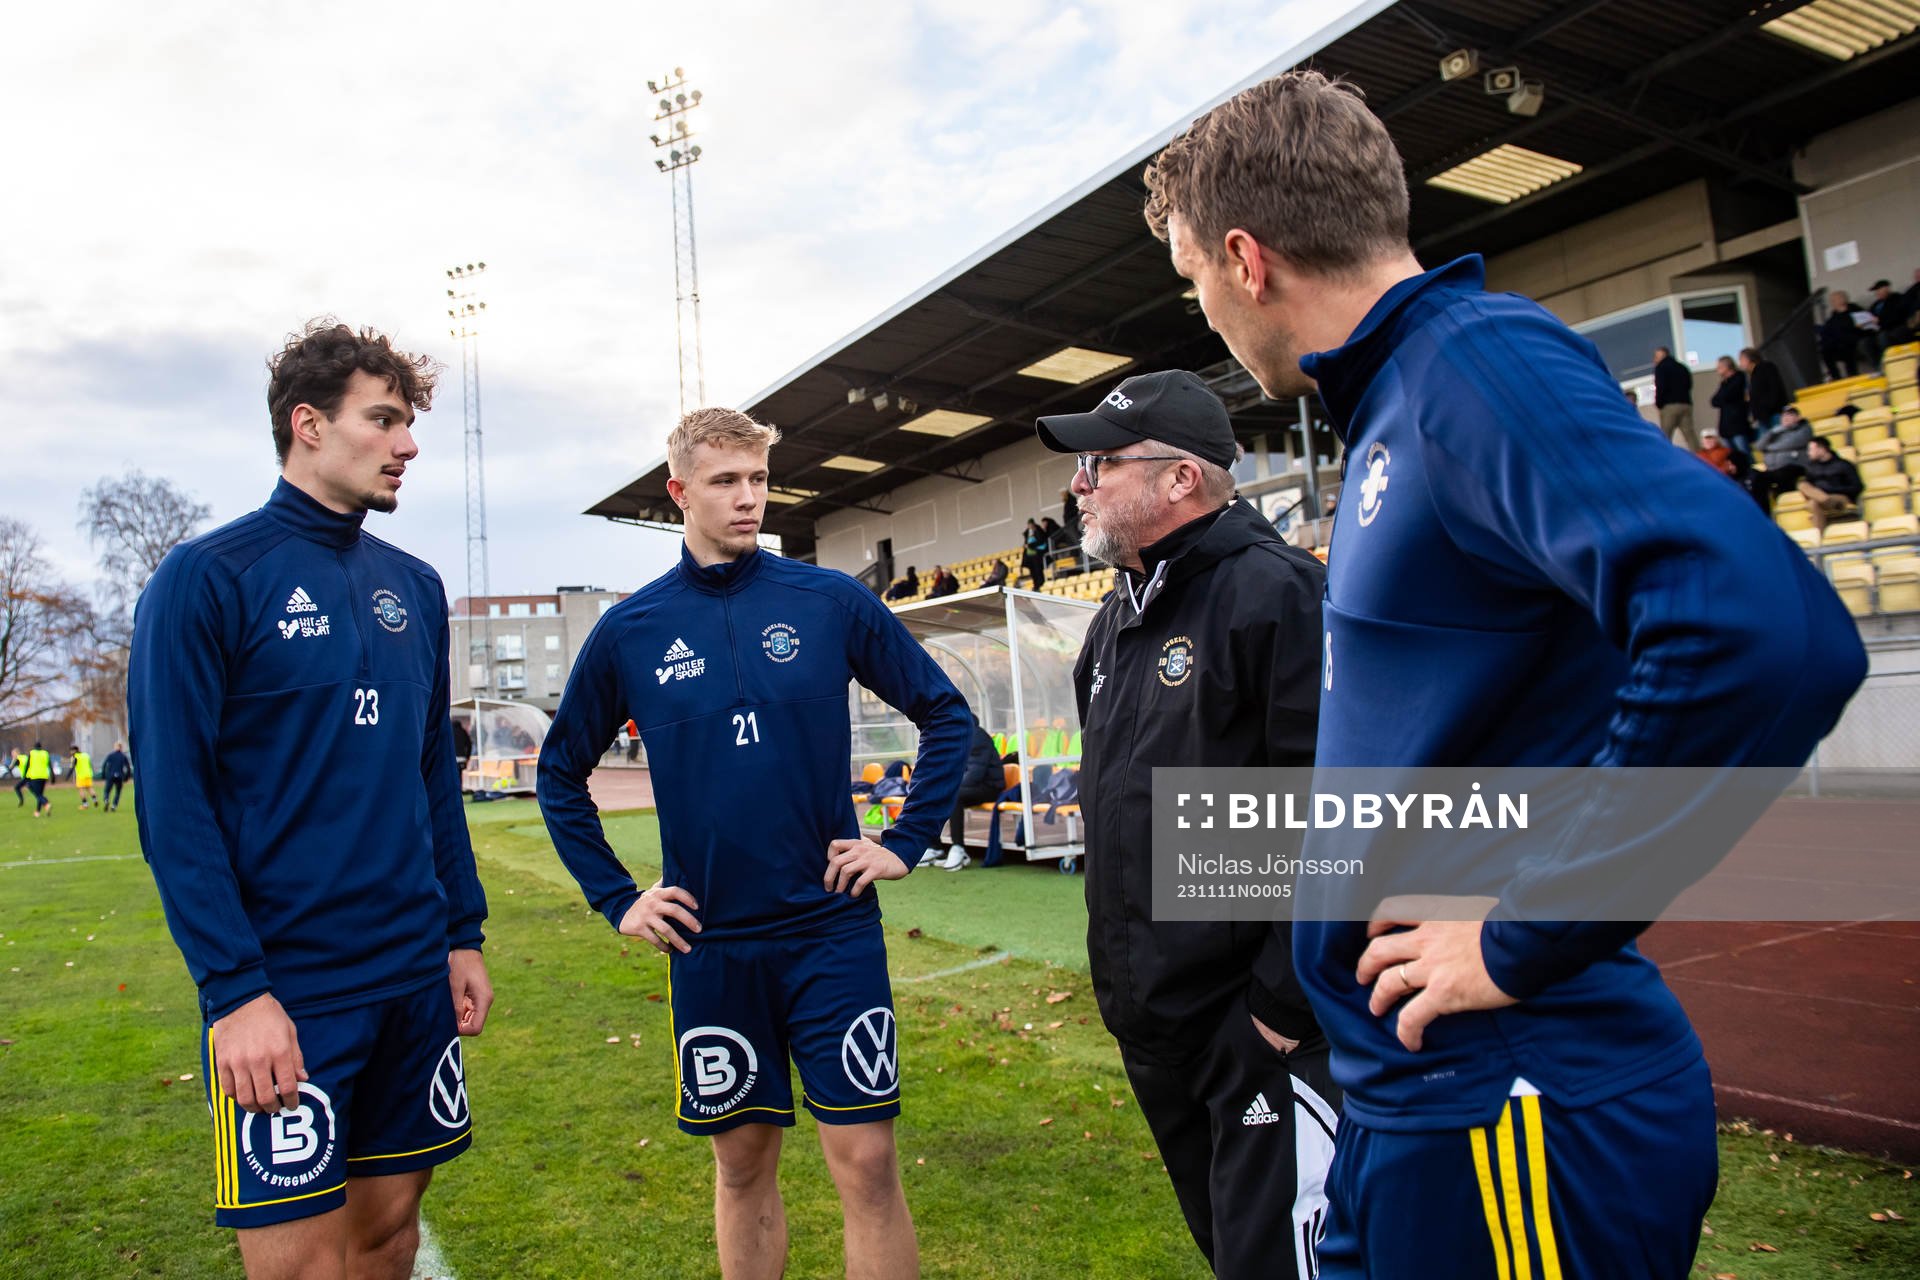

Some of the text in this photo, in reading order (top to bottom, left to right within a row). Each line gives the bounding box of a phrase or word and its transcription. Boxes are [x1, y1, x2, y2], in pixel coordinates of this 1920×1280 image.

[286, 602, 318, 613] adidas
[663, 649, 694, 662] adidas
[674, 658, 705, 672] INTER
[675, 667, 705, 681] SPORT
[354, 688, 379, 725] 23
[732, 711, 760, 746] 21
[692, 1100, 699, 1109] &
[699, 1074, 757, 1115] BYGGMASKINER
[1242, 1111, 1280, 1126] adidas
[246, 1142, 335, 1187] LYFT & BYGGMASKINER
